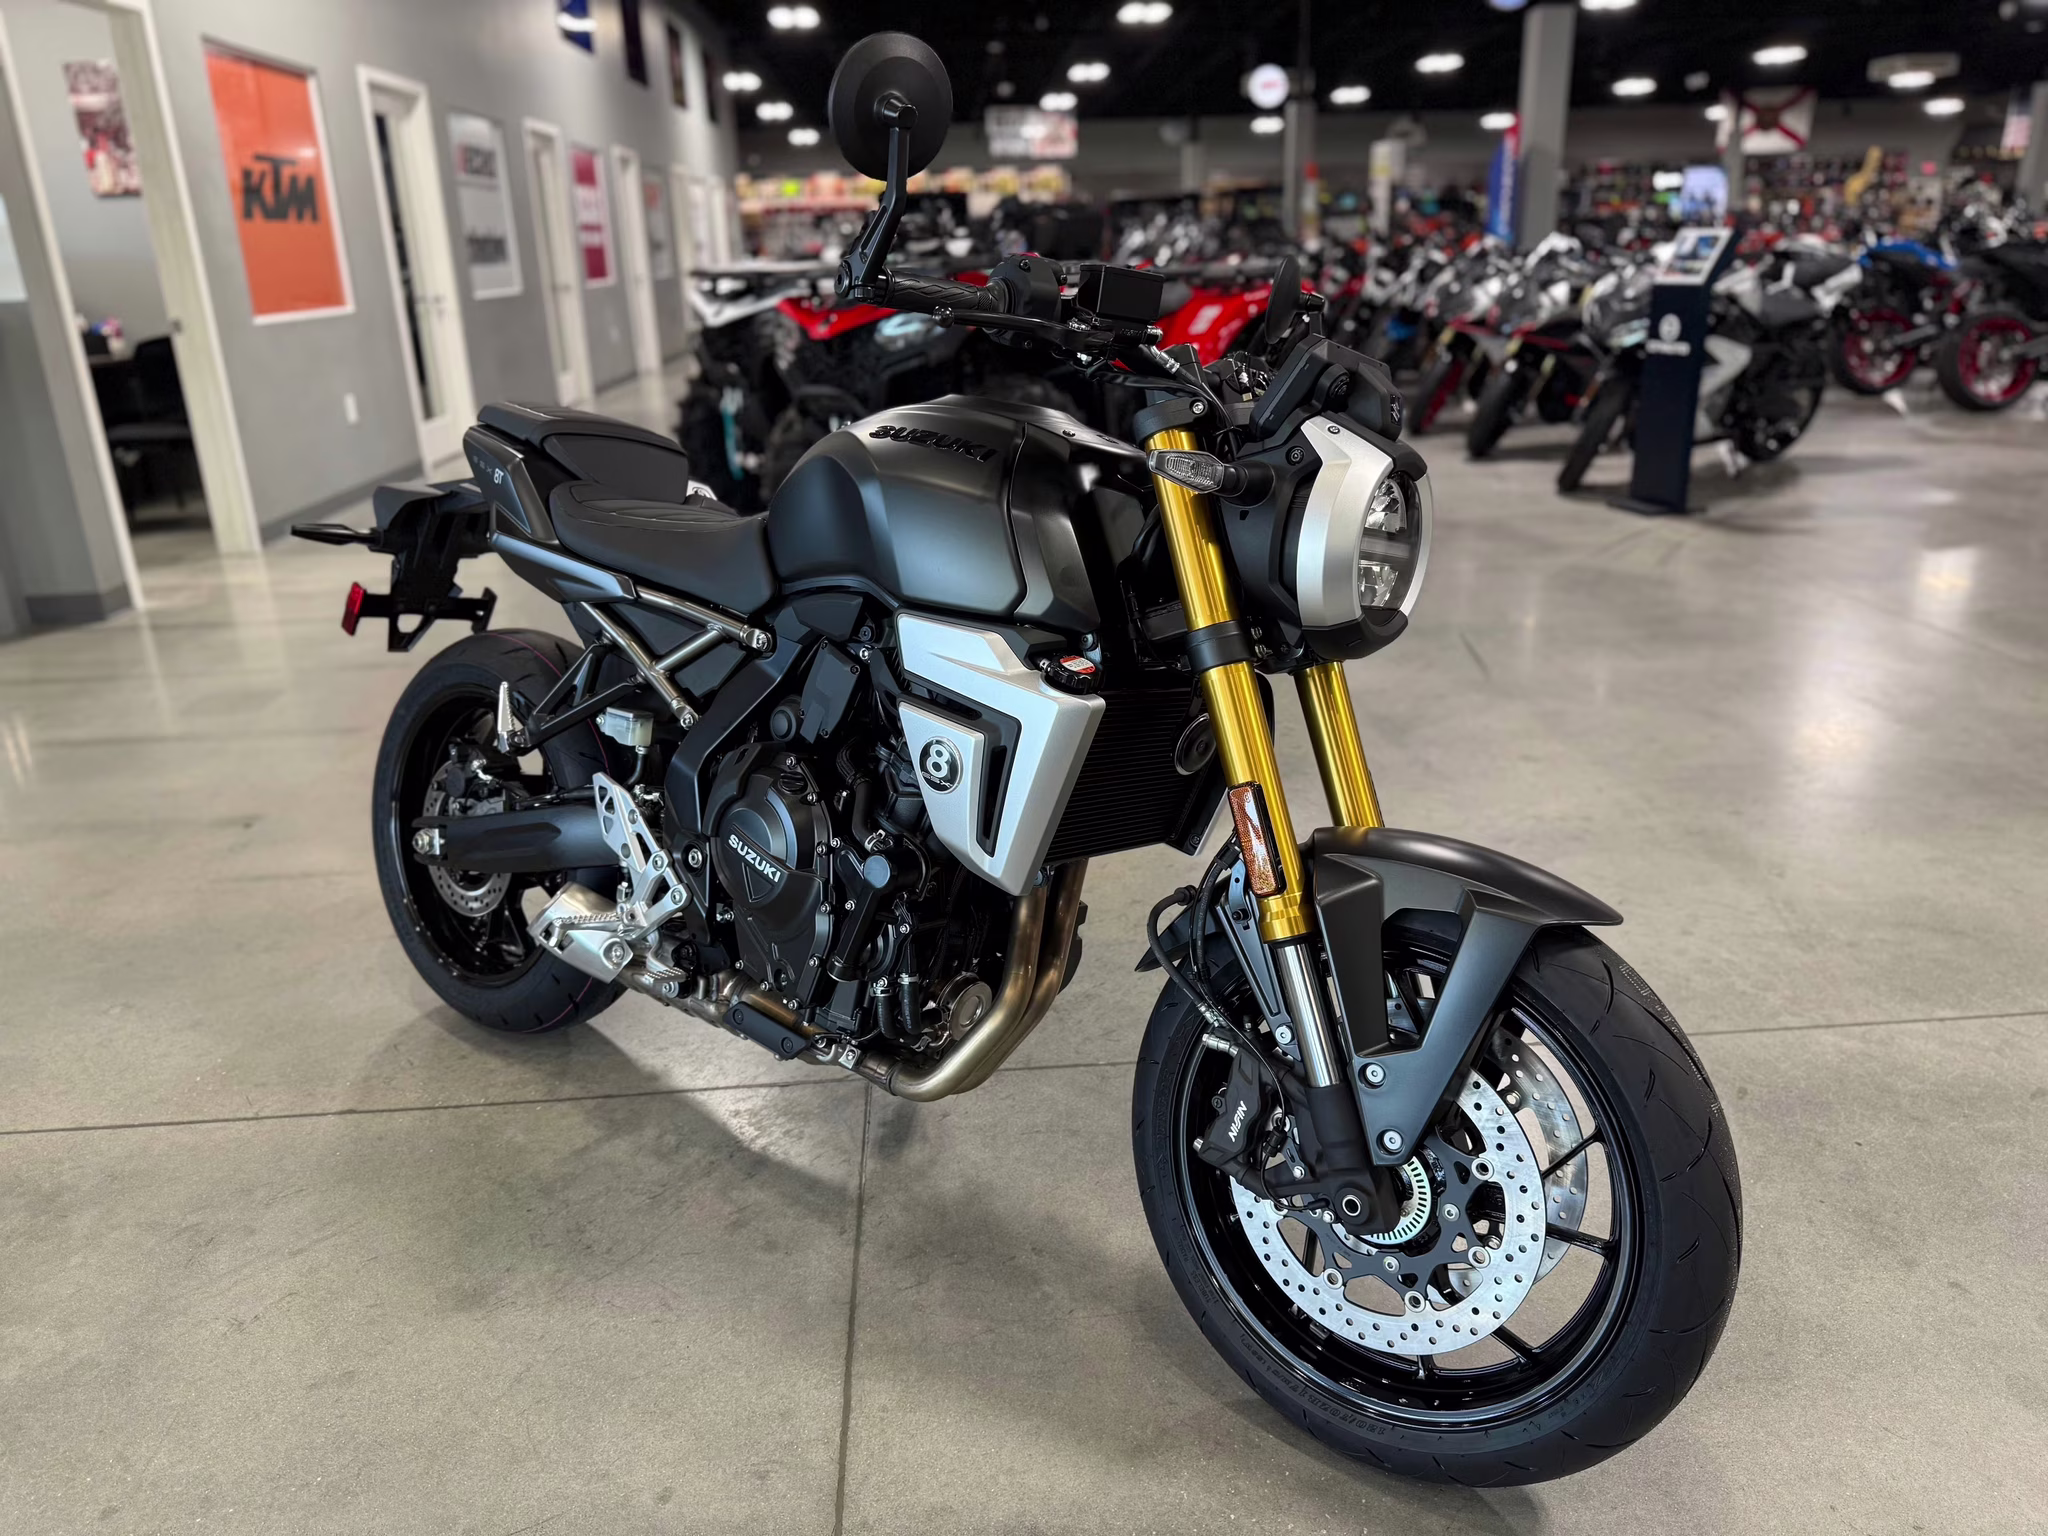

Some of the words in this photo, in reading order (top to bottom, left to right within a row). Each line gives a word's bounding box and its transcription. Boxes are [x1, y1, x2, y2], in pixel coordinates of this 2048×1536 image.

[242, 154, 318, 221] KTM
[869, 425, 998, 462] SUZUKI
[494, 467, 504, 485] 8T
[926, 744, 949, 778] 8
[728, 834, 781, 883] SUZUKI
[1228, 1100, 1248, 1143] NISSIN
